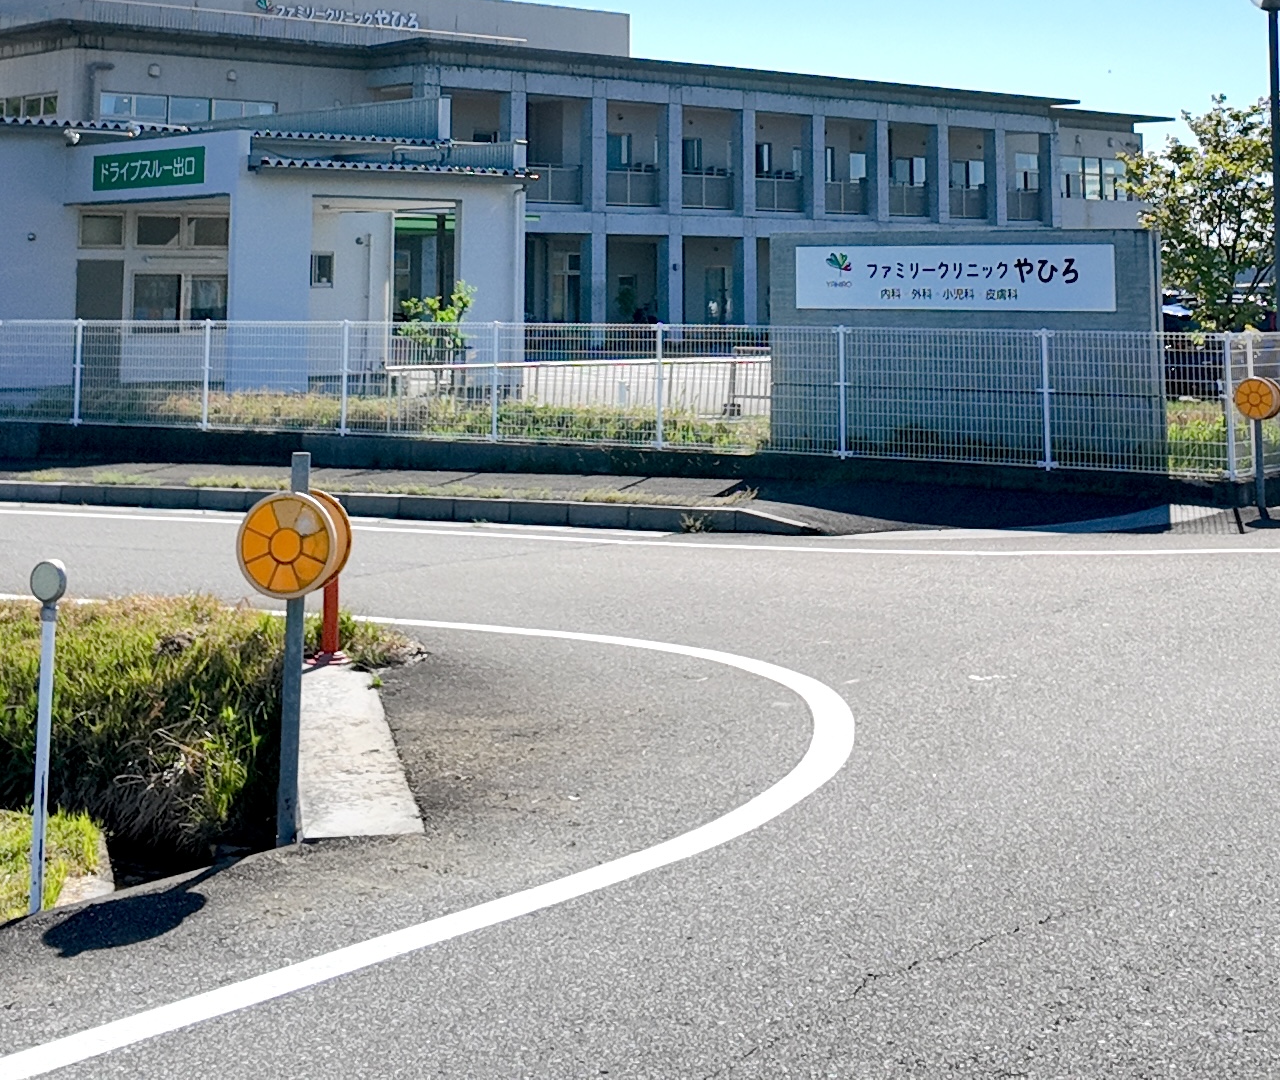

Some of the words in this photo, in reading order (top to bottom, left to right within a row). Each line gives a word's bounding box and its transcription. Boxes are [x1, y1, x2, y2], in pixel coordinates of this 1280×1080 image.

[101, 157, 195, 183] ドライブスルー出口
